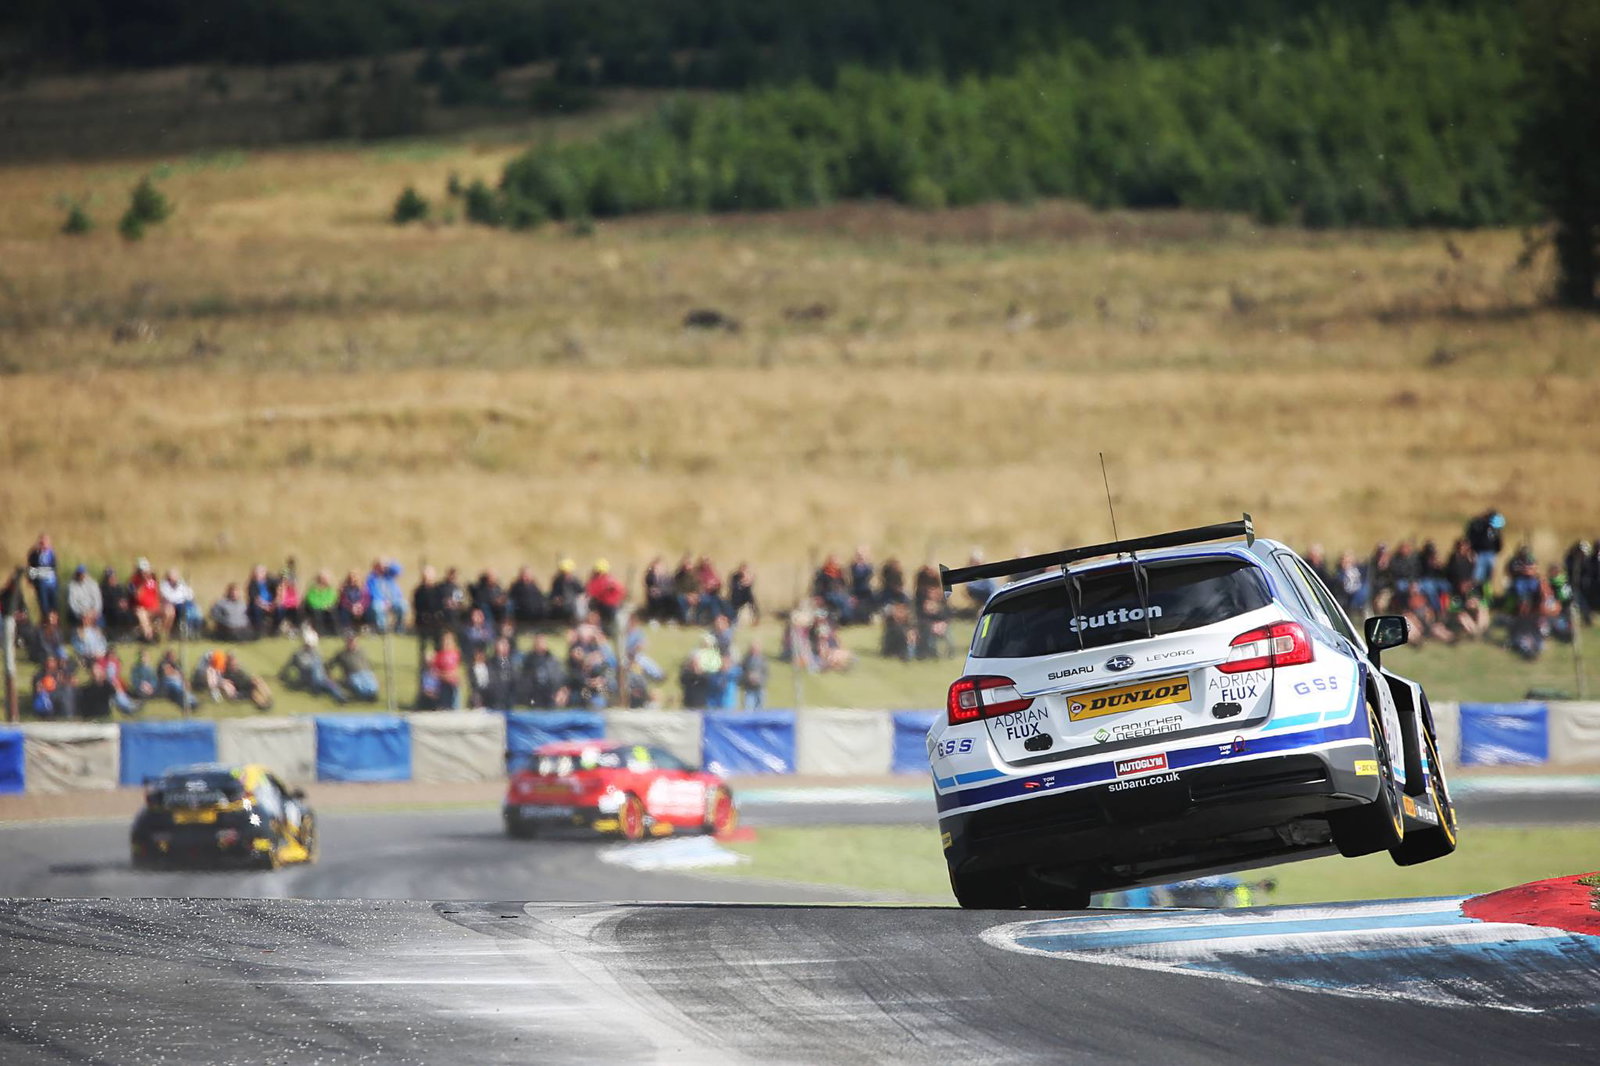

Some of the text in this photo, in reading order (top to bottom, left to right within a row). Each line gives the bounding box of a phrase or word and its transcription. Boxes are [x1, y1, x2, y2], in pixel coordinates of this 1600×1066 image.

[981, 614, 992, 638] 1
[1069, 605, 1162, 632] Sutton
[1146, 649, 1195, 662] LEVORG
[1048, 665, 1094, 680] SUBARU
[1208, 671, 1266, 690] ADRIAN
[1222, 685, 1257, 702] FLUX
[1293, 676, 1338, 695] GSS
[1089, 684, 1187, 710] DUNLOP
[995, 707, 1048, 729] ADRIAN
[1112, 715, 1183, 733] CROUCHER
[1007, 722, 1041, 740] FLUX
[1116, 723, 1181, 740] NEEDHAM
[938, 739, 972, 757] GSS
[1218, 744, 1232, 752] TOW
[1119, 757, 1163, 773] AUTOGLYM
[1108, 771, 1180, 792] subaru.co.uk
